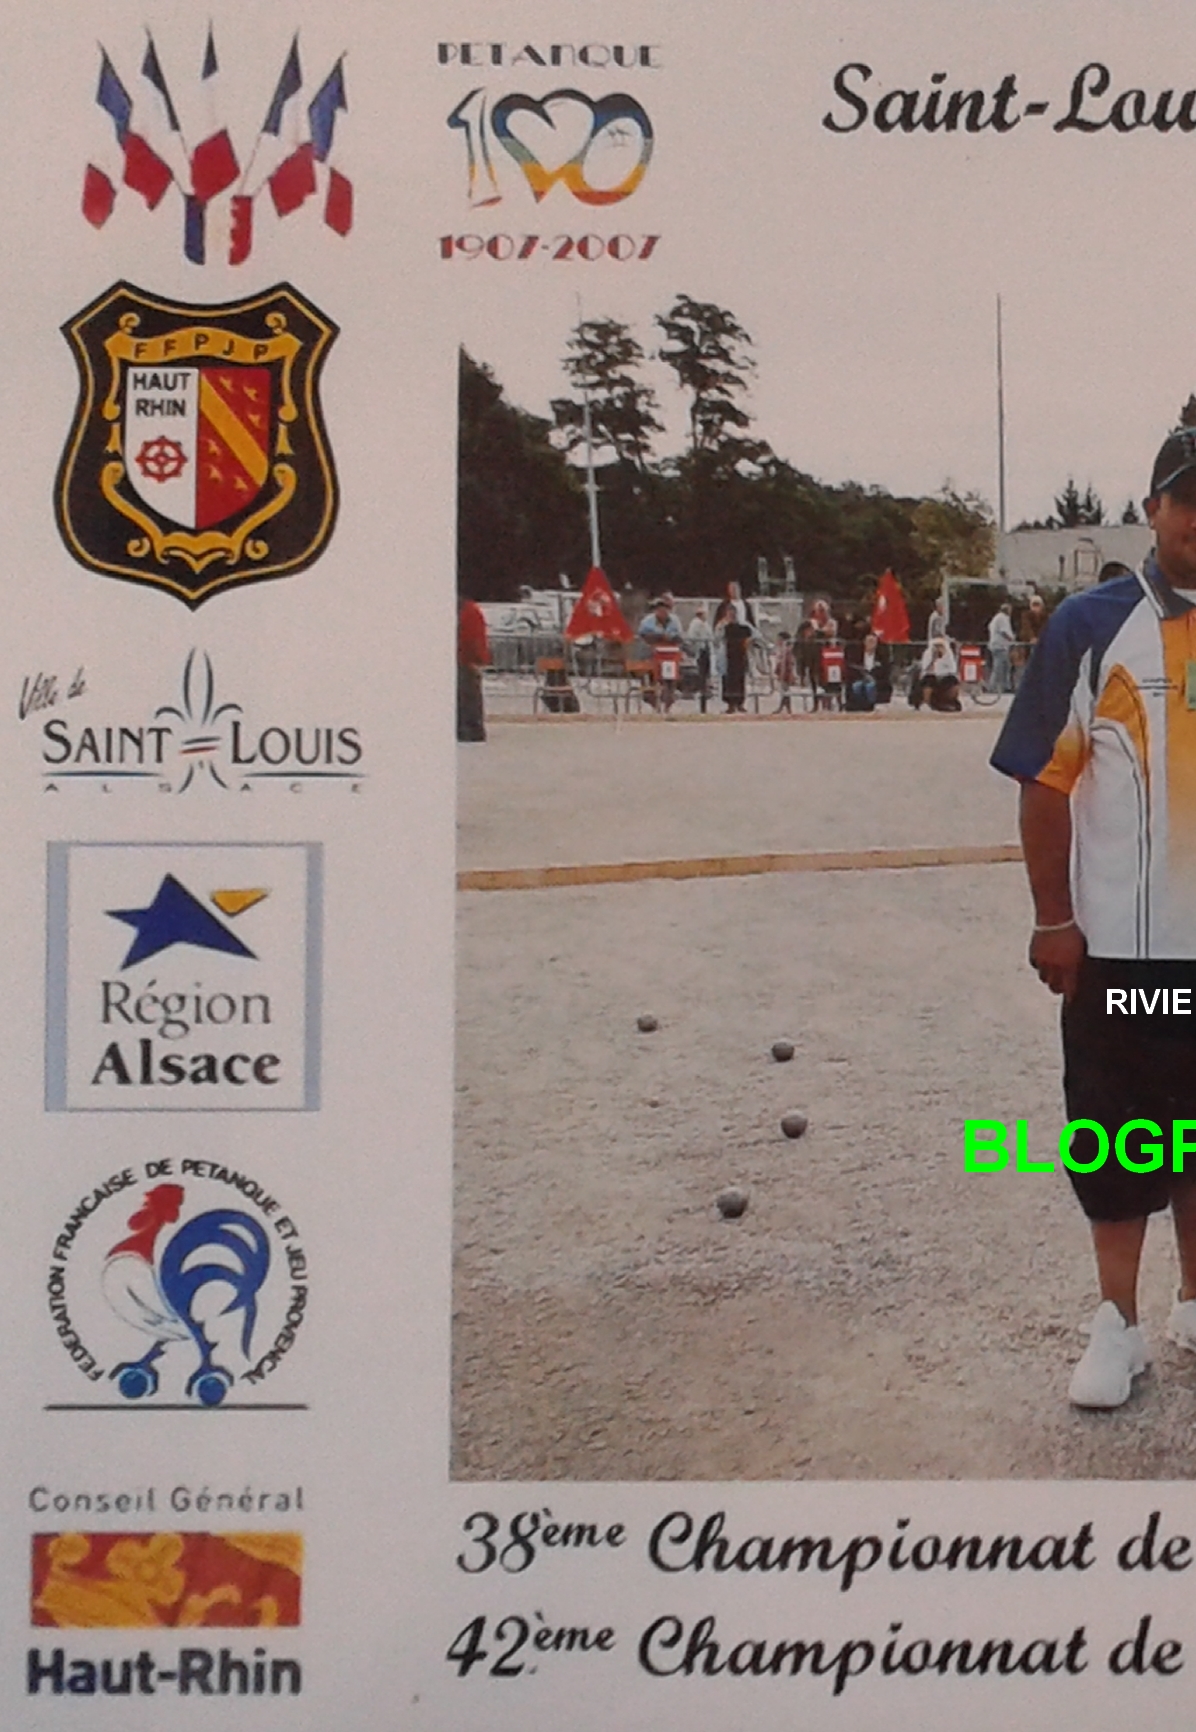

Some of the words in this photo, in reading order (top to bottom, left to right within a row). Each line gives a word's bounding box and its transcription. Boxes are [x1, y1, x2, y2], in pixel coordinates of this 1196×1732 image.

[437, 42, 662, 68] PETANQUE
[439, 233, 662, 262] 1907-2007
[133, 372, 191, 391] HAUT
[135, 399, 186, 417] RHIN
[19, 671, 59, 721] Ville
[101, 979, 272, 1040] Région
[91, 1039, 281, 1086] Alsace
[145, 1158, 173, 1179] DE
[181, 1158, 280, 1217] PETANQUE
[274, 1216, 298, 1240] ET
[284, 1243, 308, 1281] JEU
[29, 1487, 155, 1512] Conseil
[170, 1485, 304, 1512] Général
[456, 1510, 626, 1573] 38ème
[648, 1511, 1096, 1591] Championnat
[1117, 1511, 1194, 1573] de
[445, 1612, 616, 1678] 42ème
[637, 1615, 1090, 1695] Championnat
[1108, 1615, 1184, 1677] de
[27, 1649, 302, 1697] Haut-Rhin
